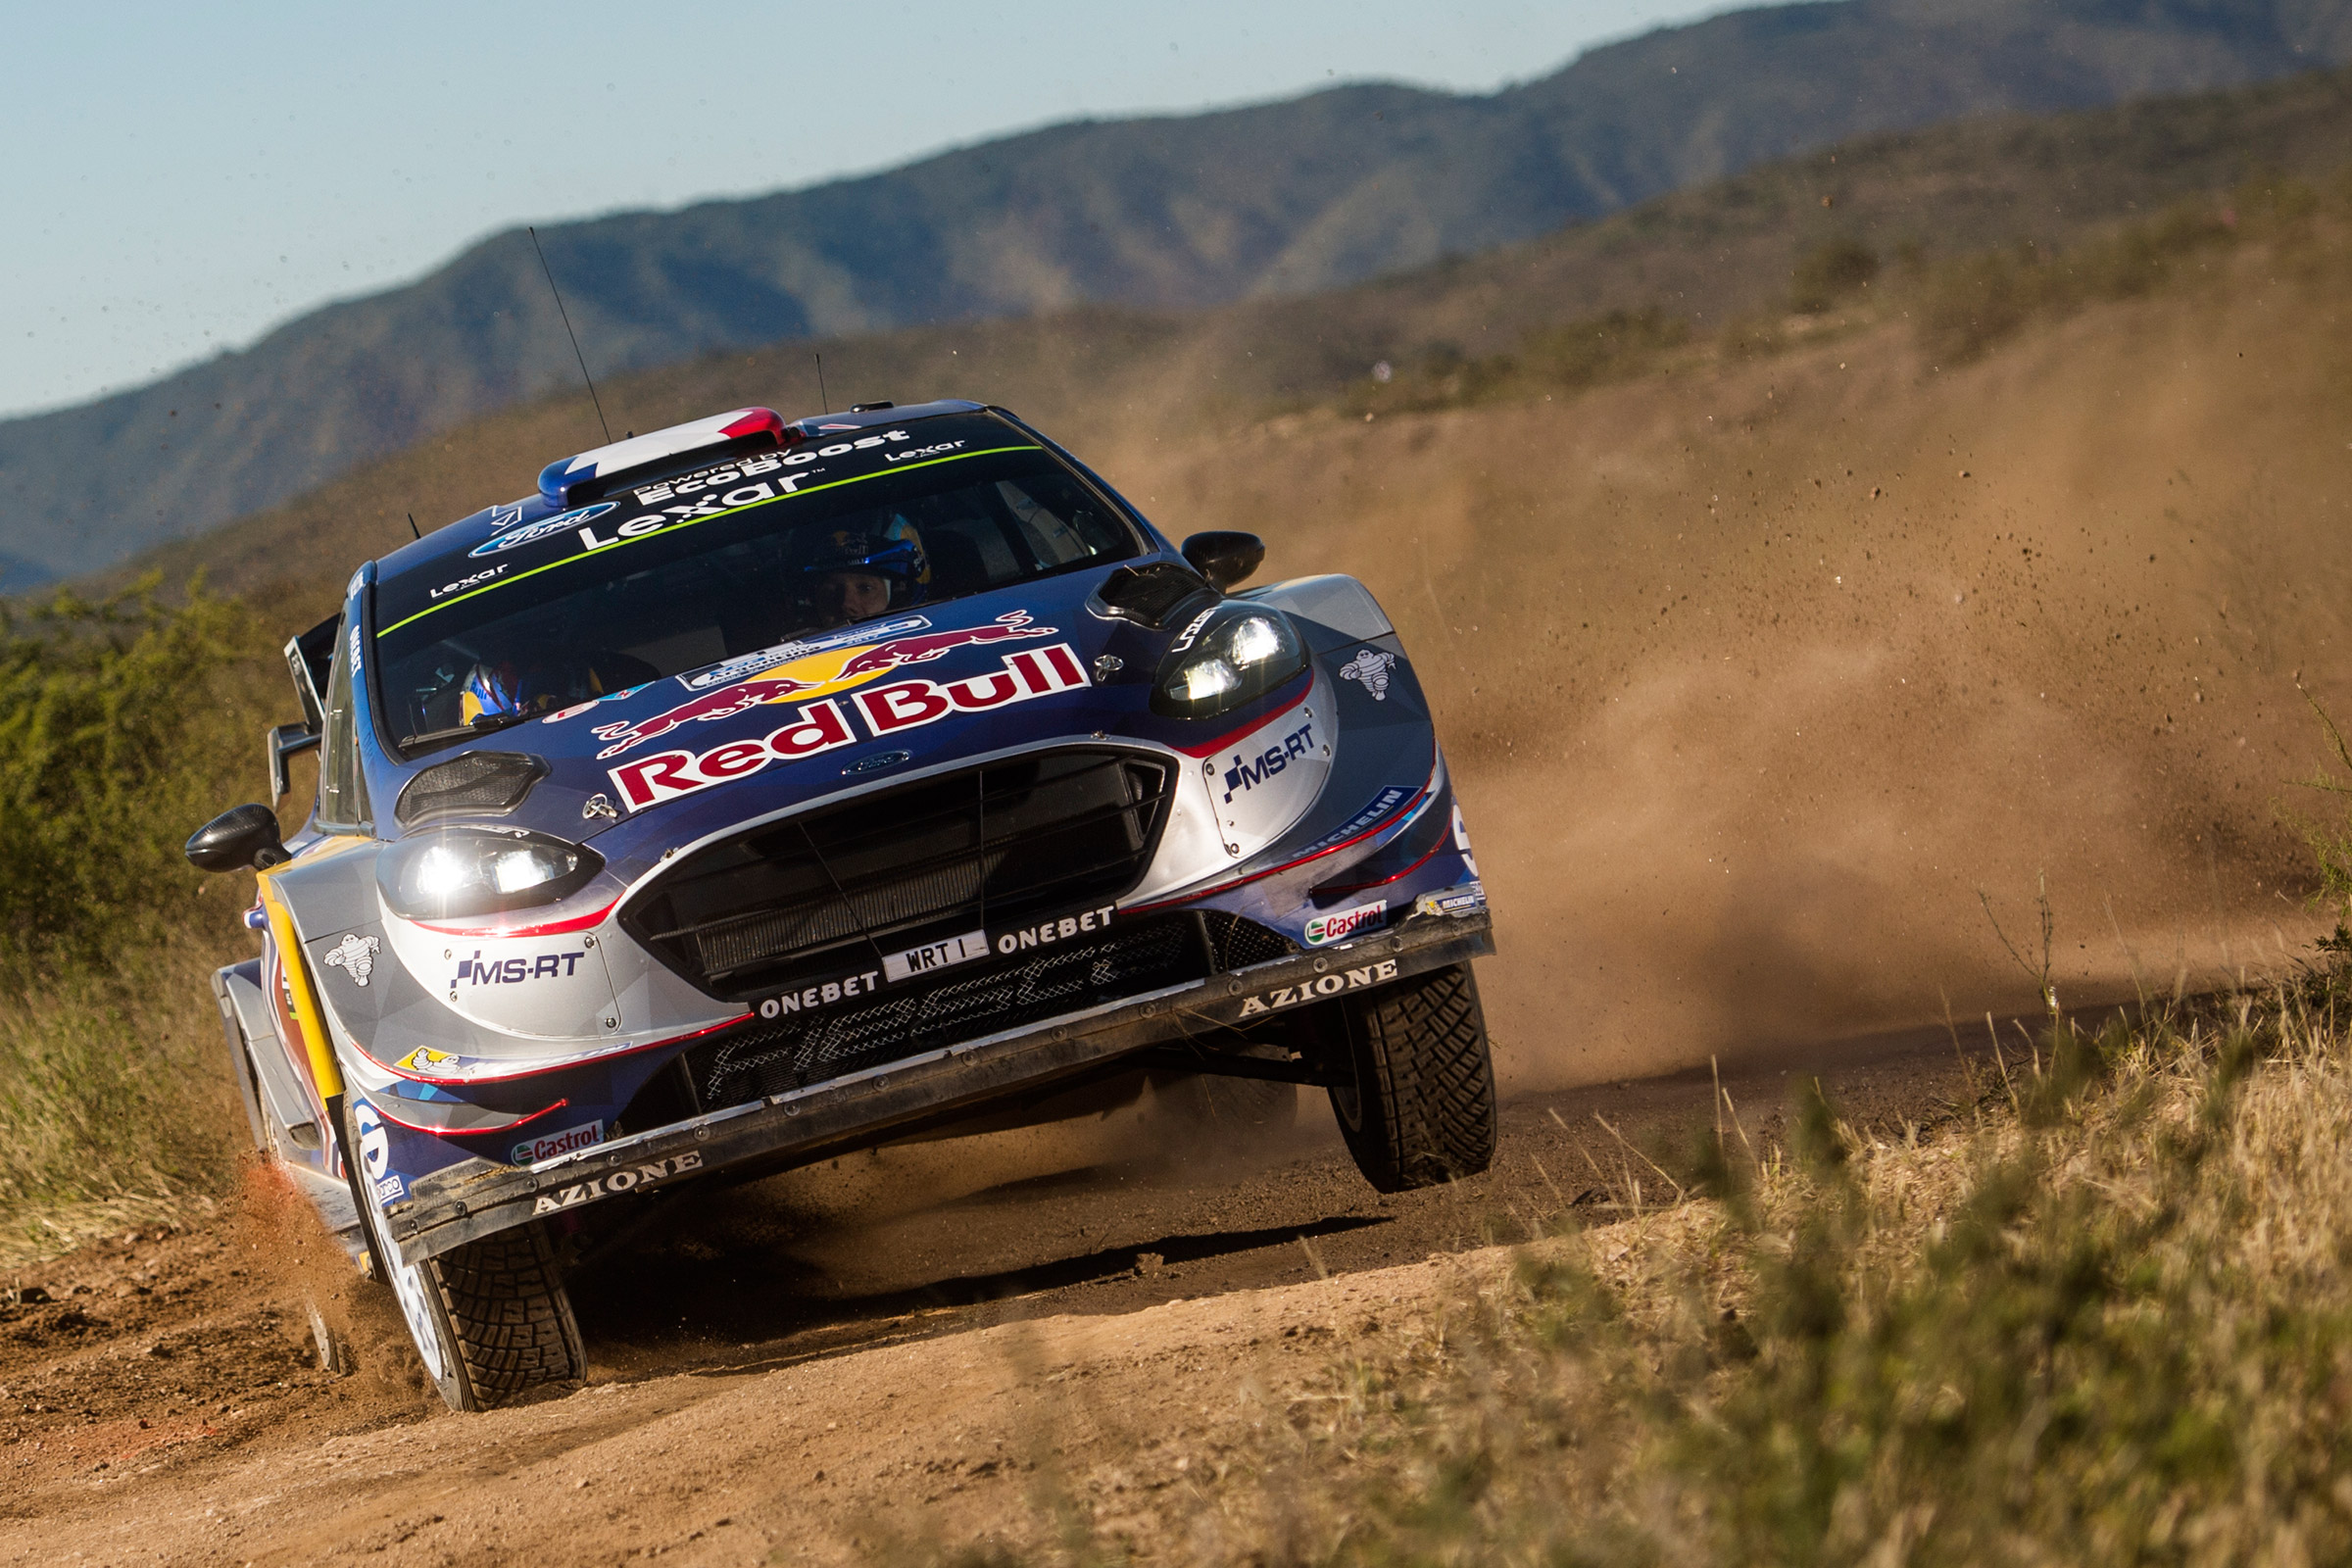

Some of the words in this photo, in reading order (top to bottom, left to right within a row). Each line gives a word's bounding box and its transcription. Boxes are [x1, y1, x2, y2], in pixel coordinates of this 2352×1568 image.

[633, 457, 754, 496] powered
[759, 448, 792, 462] by
[637, 429, 909, 507] EcoBoost
[884, 438, 966, 463] Lexar
[496, 508, 592, 550] Ford
[578, 470, 810, 552] Lexar
[429, 563, 510, 599] Lexar
[612, 702, 854, 809] Red
[858, 646, 1089, 733] Bull
[1292, 789, 1402, 859] MICHELIN
[997, 906, 1114, 955] ONEBET
[1325, 904, 1385, 939] Castrol
[906, 940, 955, 974] WRT
[759, 970, 879, 1019] ONEBET
[1238, 958, 1399, 1018] AZIONE
[533, 1124, 600, 1160] Castrol
[531, 1150, 704, 1216] AZIONE
